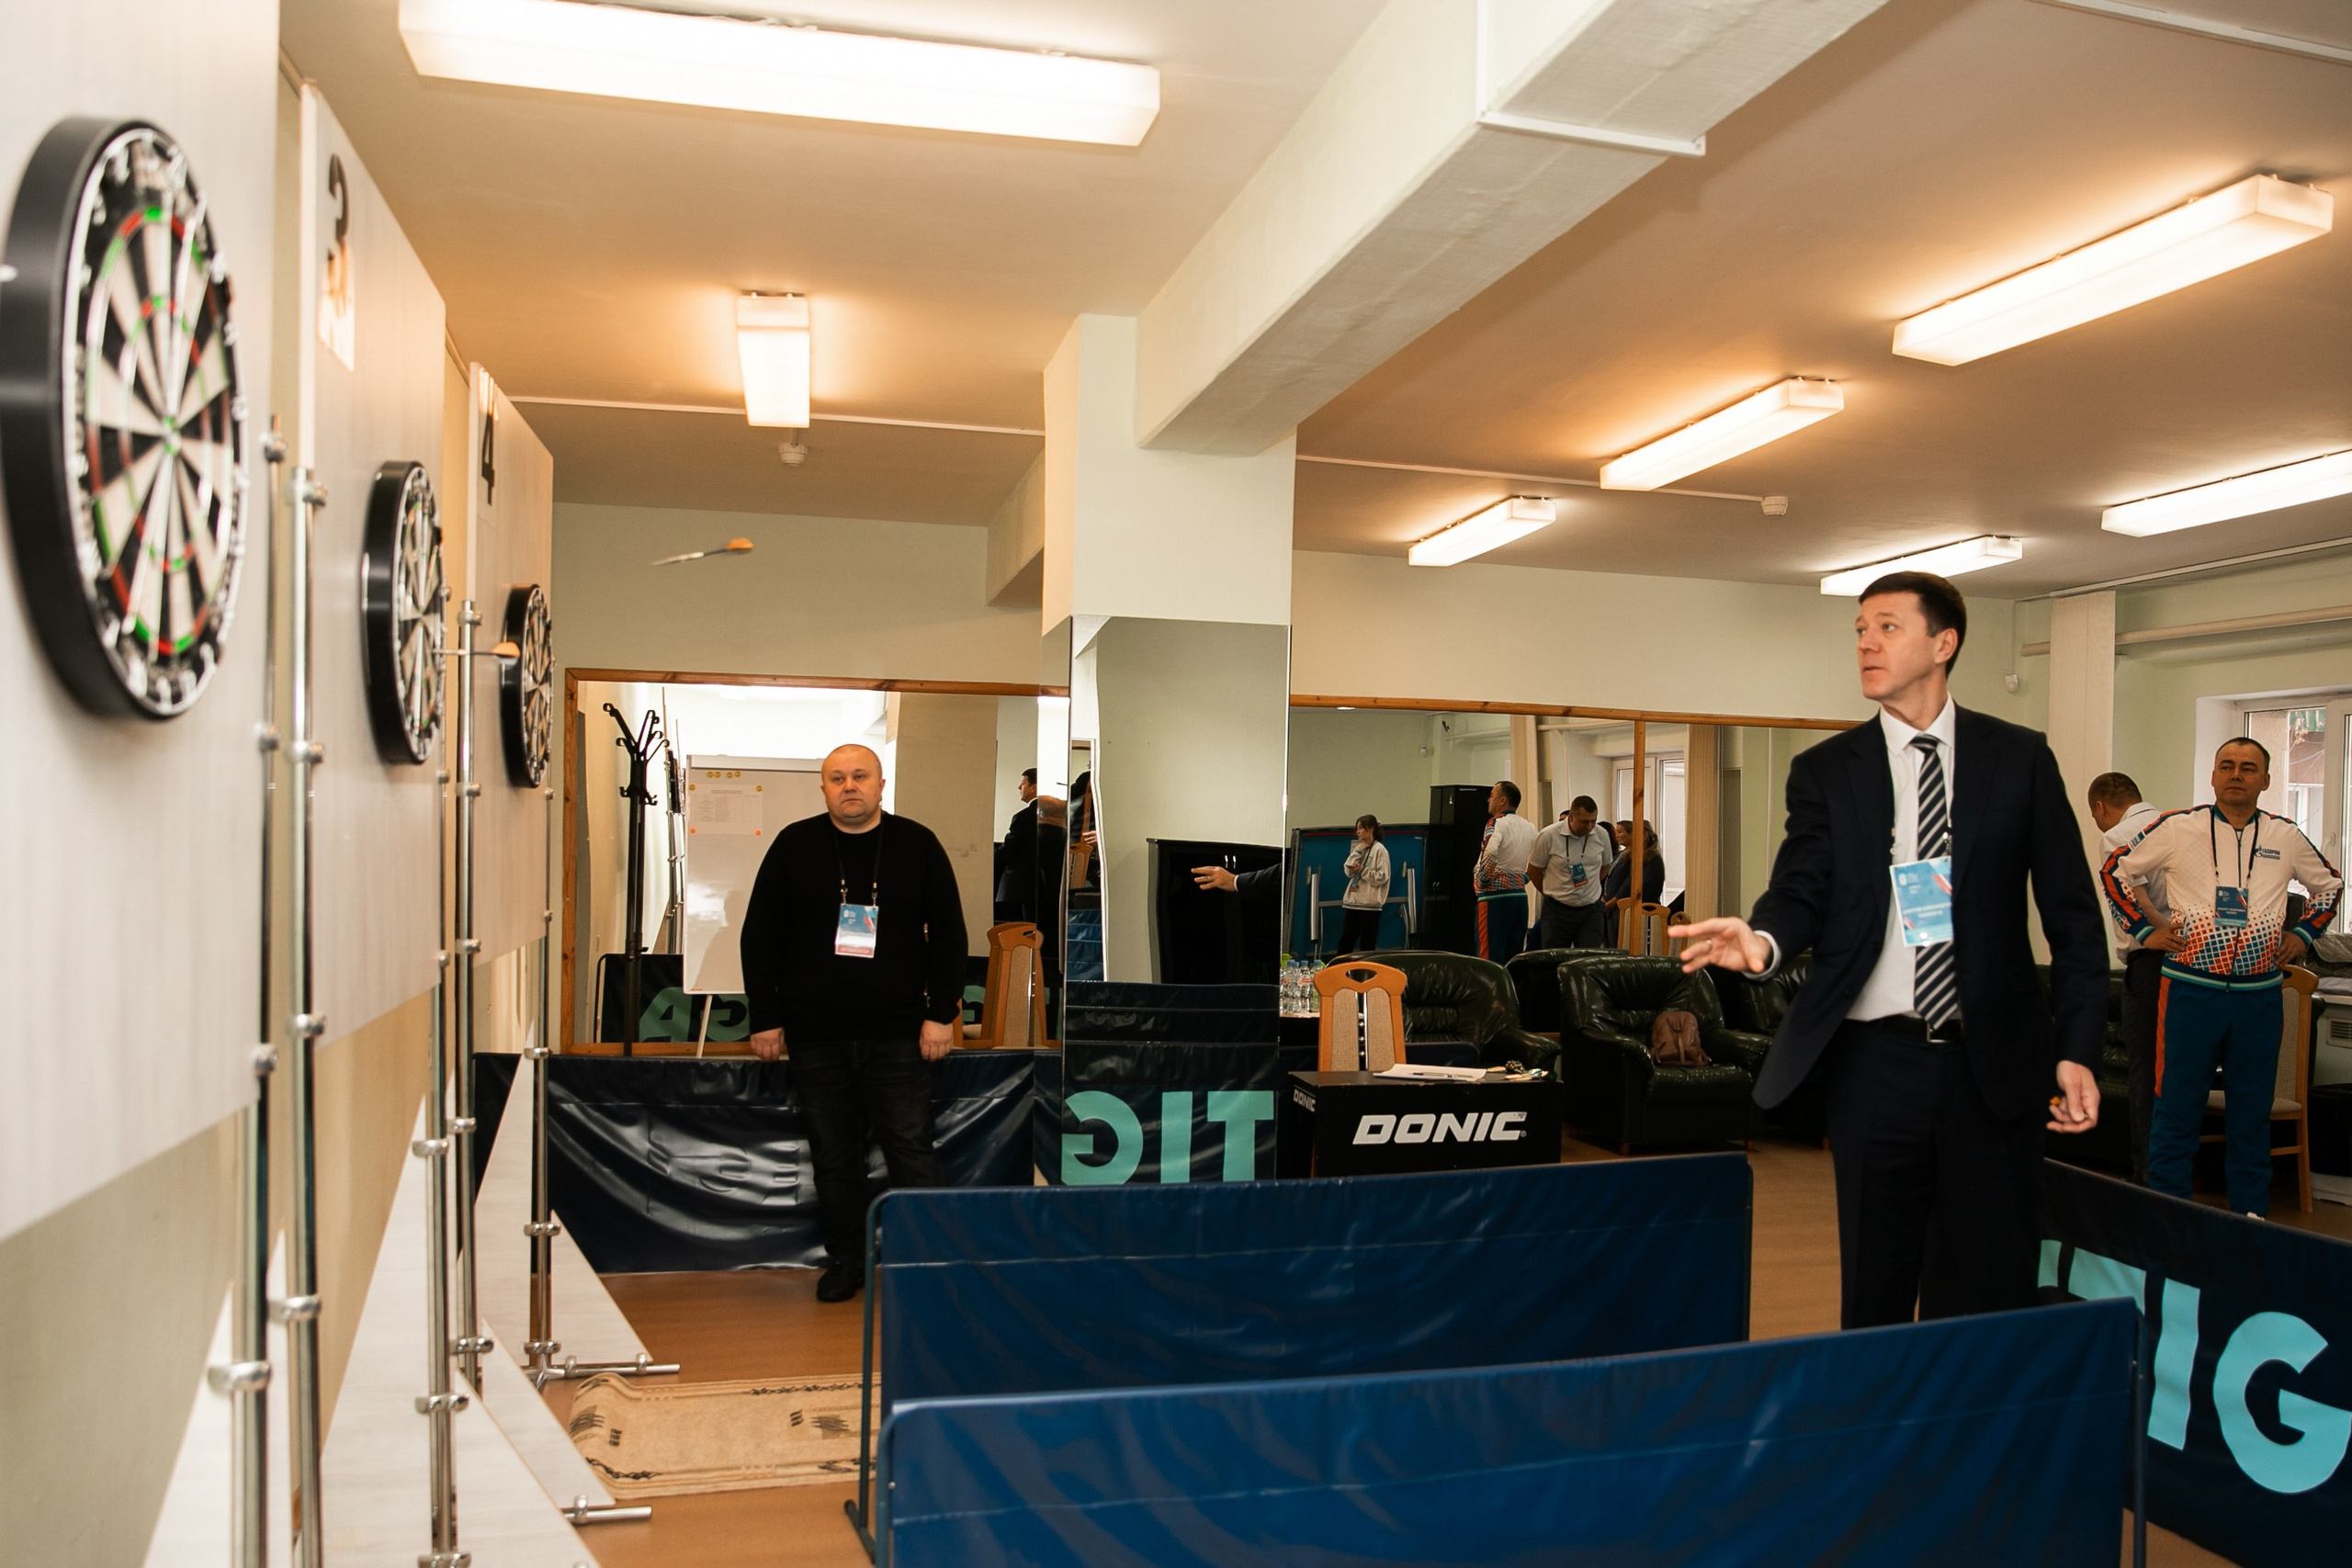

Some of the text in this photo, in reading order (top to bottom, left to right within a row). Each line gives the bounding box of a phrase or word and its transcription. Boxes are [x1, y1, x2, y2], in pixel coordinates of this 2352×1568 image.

[326, 152, 349, 316] 3
[481, 400, 494, 506] 4
[1293, 1088, 1317, 1113] DONIC
